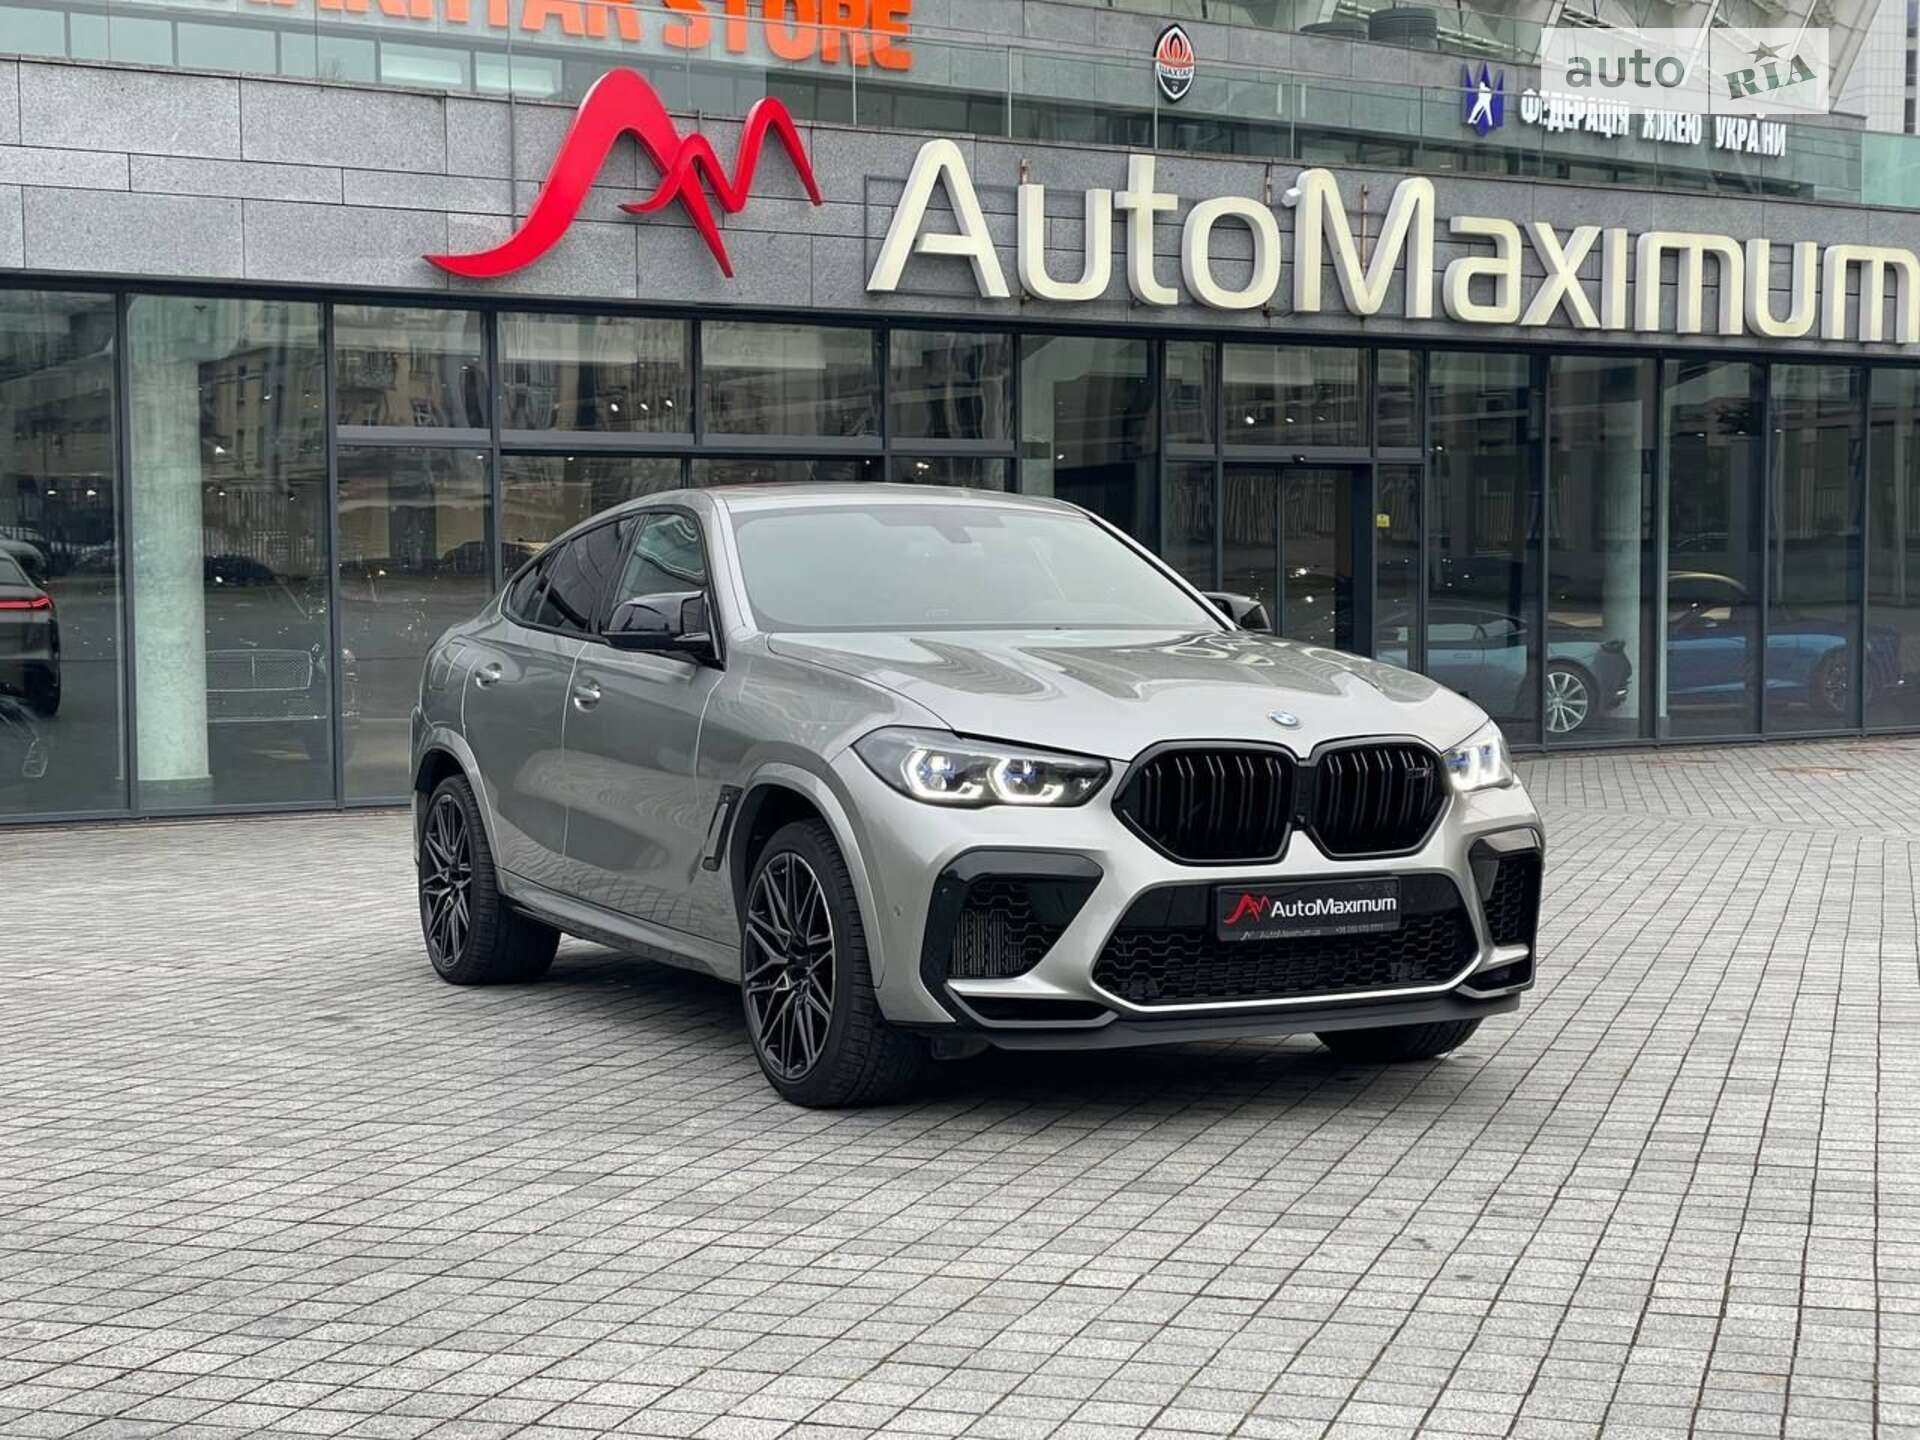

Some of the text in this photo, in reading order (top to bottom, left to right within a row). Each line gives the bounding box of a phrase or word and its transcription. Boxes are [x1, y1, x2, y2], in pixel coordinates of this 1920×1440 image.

[664, 0, 912, 70] STORE
[866, 138, 1920, 343] AutoMaximum
[1270, 897, 1397, 918] AutoMaximum
